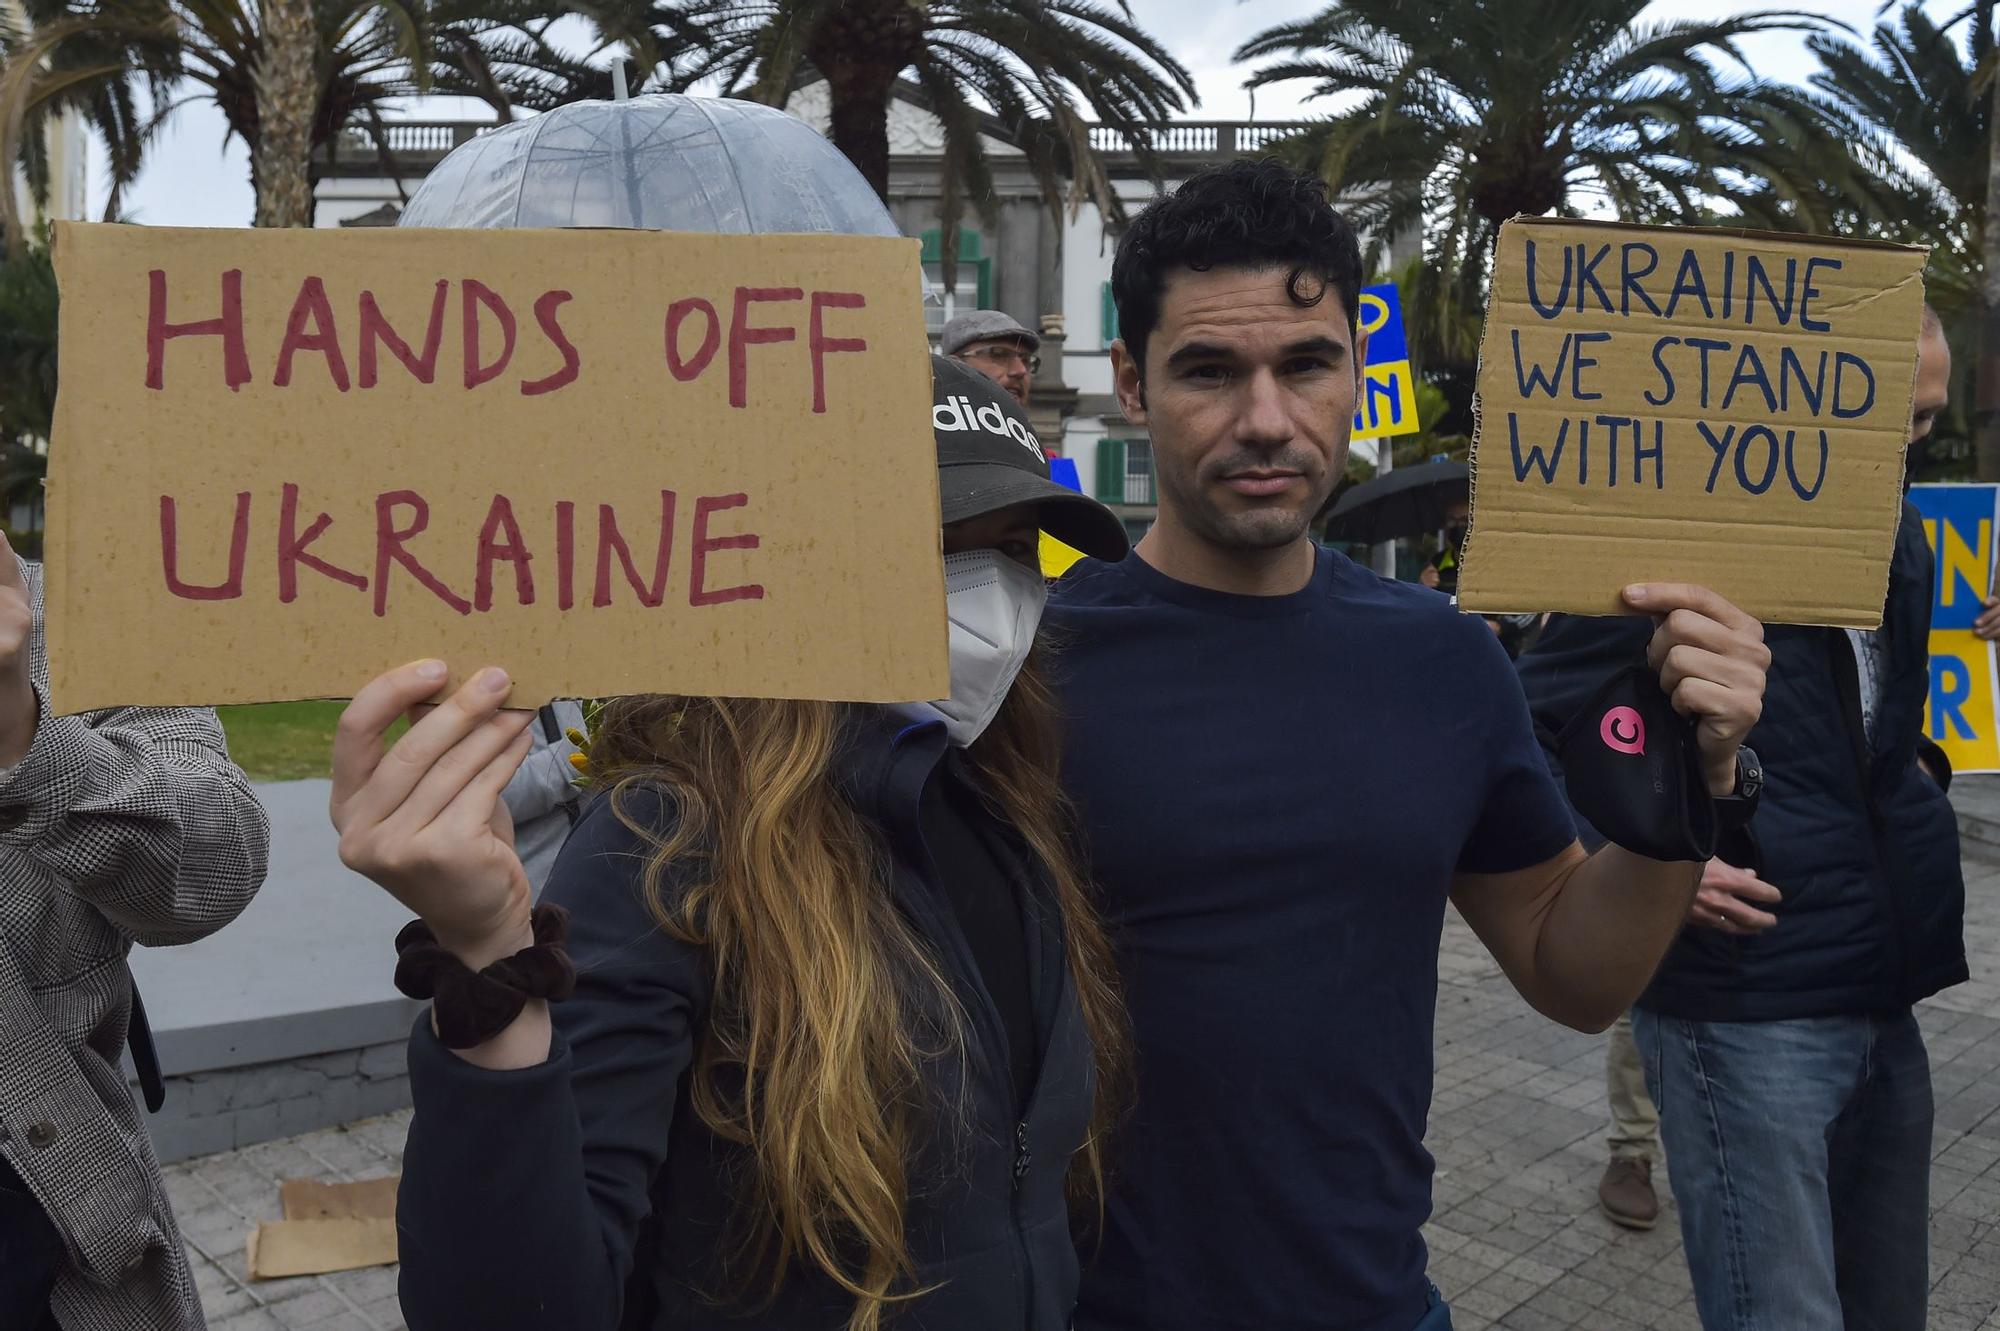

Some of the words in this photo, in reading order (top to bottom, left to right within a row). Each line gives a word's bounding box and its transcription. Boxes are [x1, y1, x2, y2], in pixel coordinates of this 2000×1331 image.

[1526, 240, 1842, 332] UKRAINE
[146, 268, 581, 396] HANDS
[665, 286, 867, 414] OFF
[1511, 329, 1612, 400] WE
[1643, 336, 1876, 418] STAND
[932, 395, 1046, 464] didas
[1508, 412, 1664, 489] WITH
[1696, 420, 1829, 501] YOU
[160, 482, 765, 617] UKRAINE
